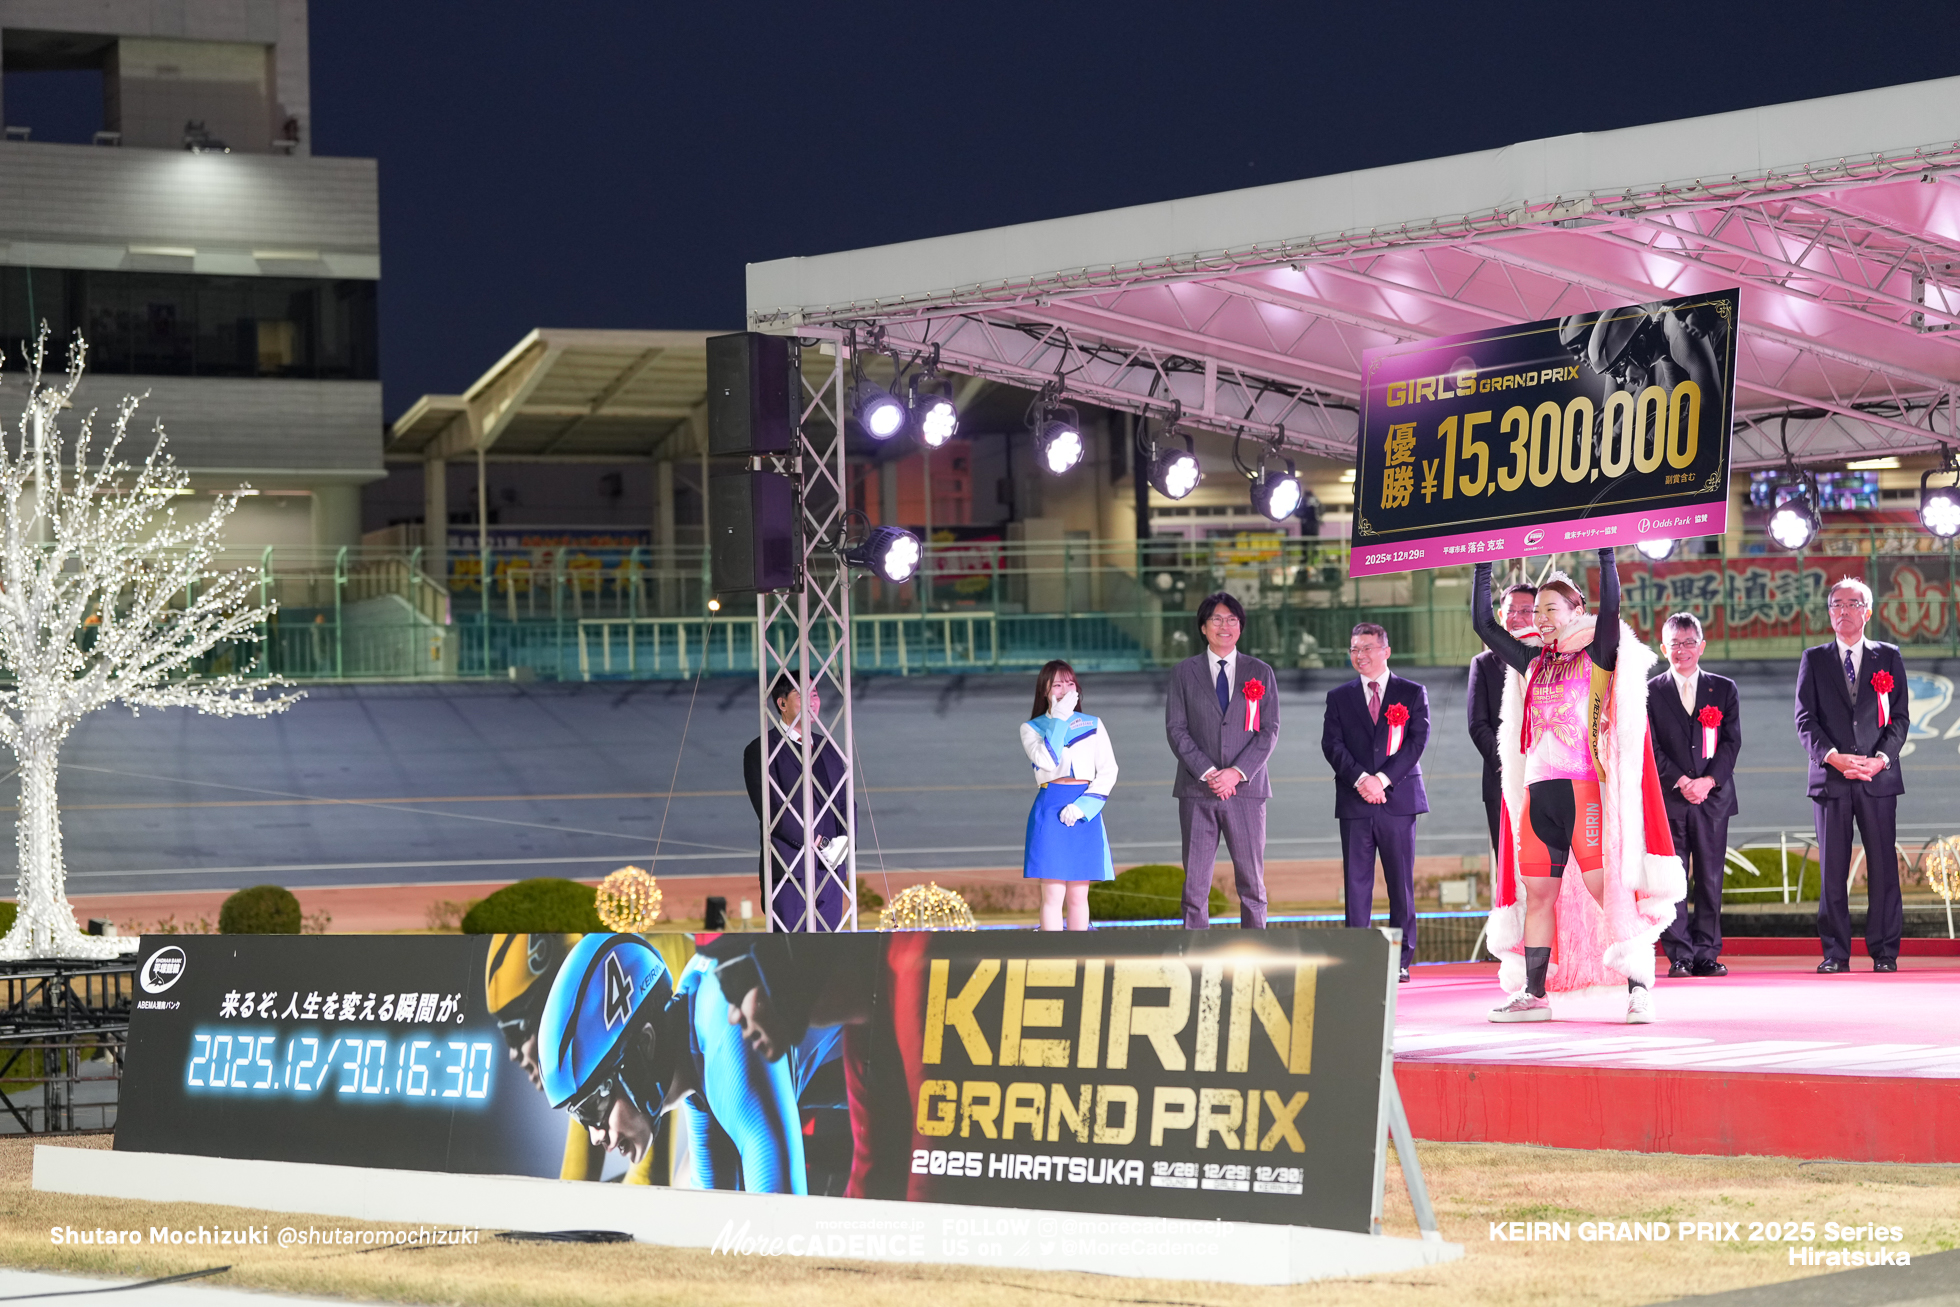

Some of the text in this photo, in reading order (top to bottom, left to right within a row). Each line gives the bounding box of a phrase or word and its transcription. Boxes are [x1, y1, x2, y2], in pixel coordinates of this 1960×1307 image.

[1386, 364, 1580, 408] GIRLS GRAND PRIX
[1421, 380, 1702, 504] ¥15,300,000
[1380, 421, 1417, 510] 優勝
[1664, 472, 1697, 486] 副賞含む
[1652, 519, 1673, 529] Odds
[1673, 515, 1693, 527] Park
[1467, 540, 1486, 554] 落合
[1529, 654, 1585, 685] CAMPION
[1533, 684, 1565, 696] GIRLS
[1585, 802, 1599, 847] KEIRIN
[604, 951, 634, 1031] 4
[639, 964, 663, 994] KEIRIN
[219, 989, 466, 1024] 来るぞ、人生を変える瞬間が。
[922, 958, 1318, 1075] KEIRIN
[916, 1079, 1310, 1153] GRAND PRIX
[911, 1149, 1144, 1186] 2025 HIRATSUKA
[1152, 1160, 1195, 1178] 12/28
[1203, 1163, 1246, 1180] 12/29
[1254, 1166, 1300, 1183] 12/30
